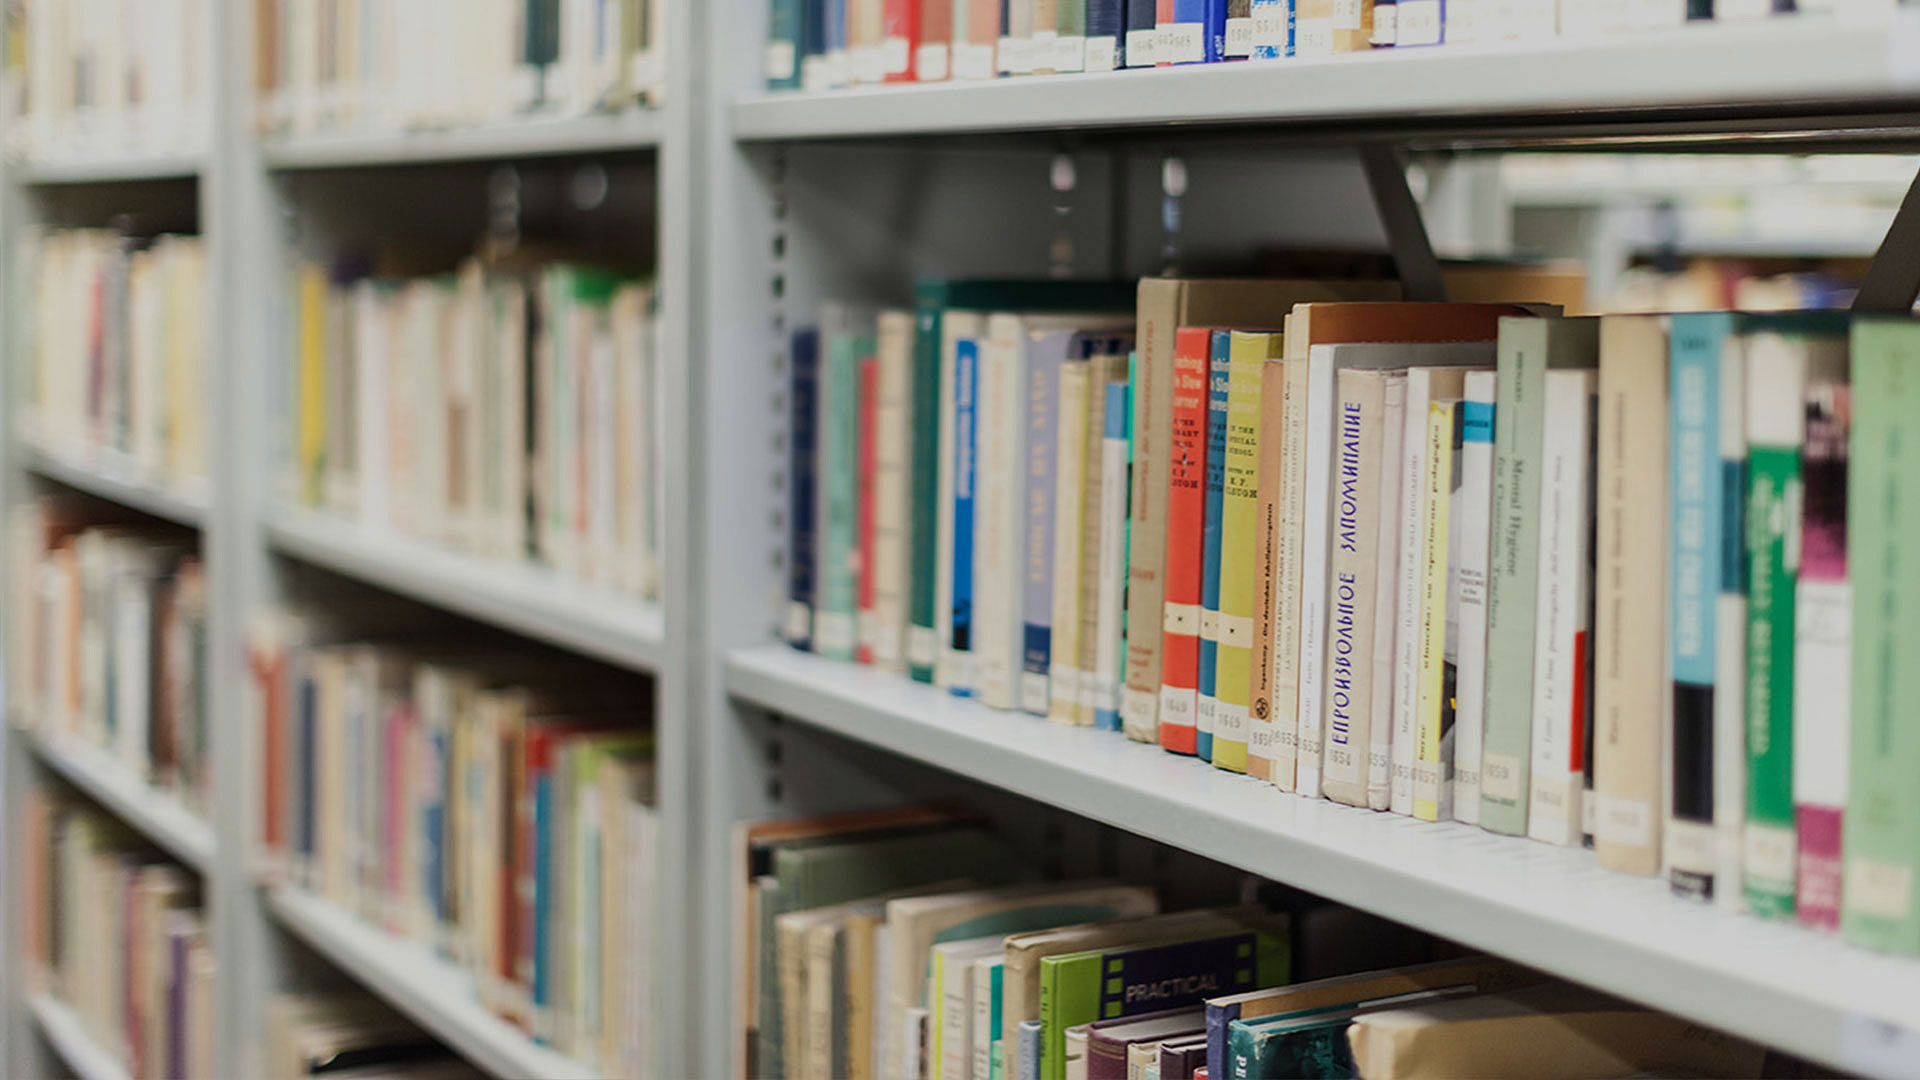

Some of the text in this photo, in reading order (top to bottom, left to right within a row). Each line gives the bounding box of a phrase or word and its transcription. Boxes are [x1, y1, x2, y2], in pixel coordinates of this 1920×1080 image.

[1339, 402, 1361, 552] ЗАПОМИНАНИЕ
[1506, 458, 1524, 578] Mental Hygiene
[1126, 975, 1219, 1004] PRACTICAL
